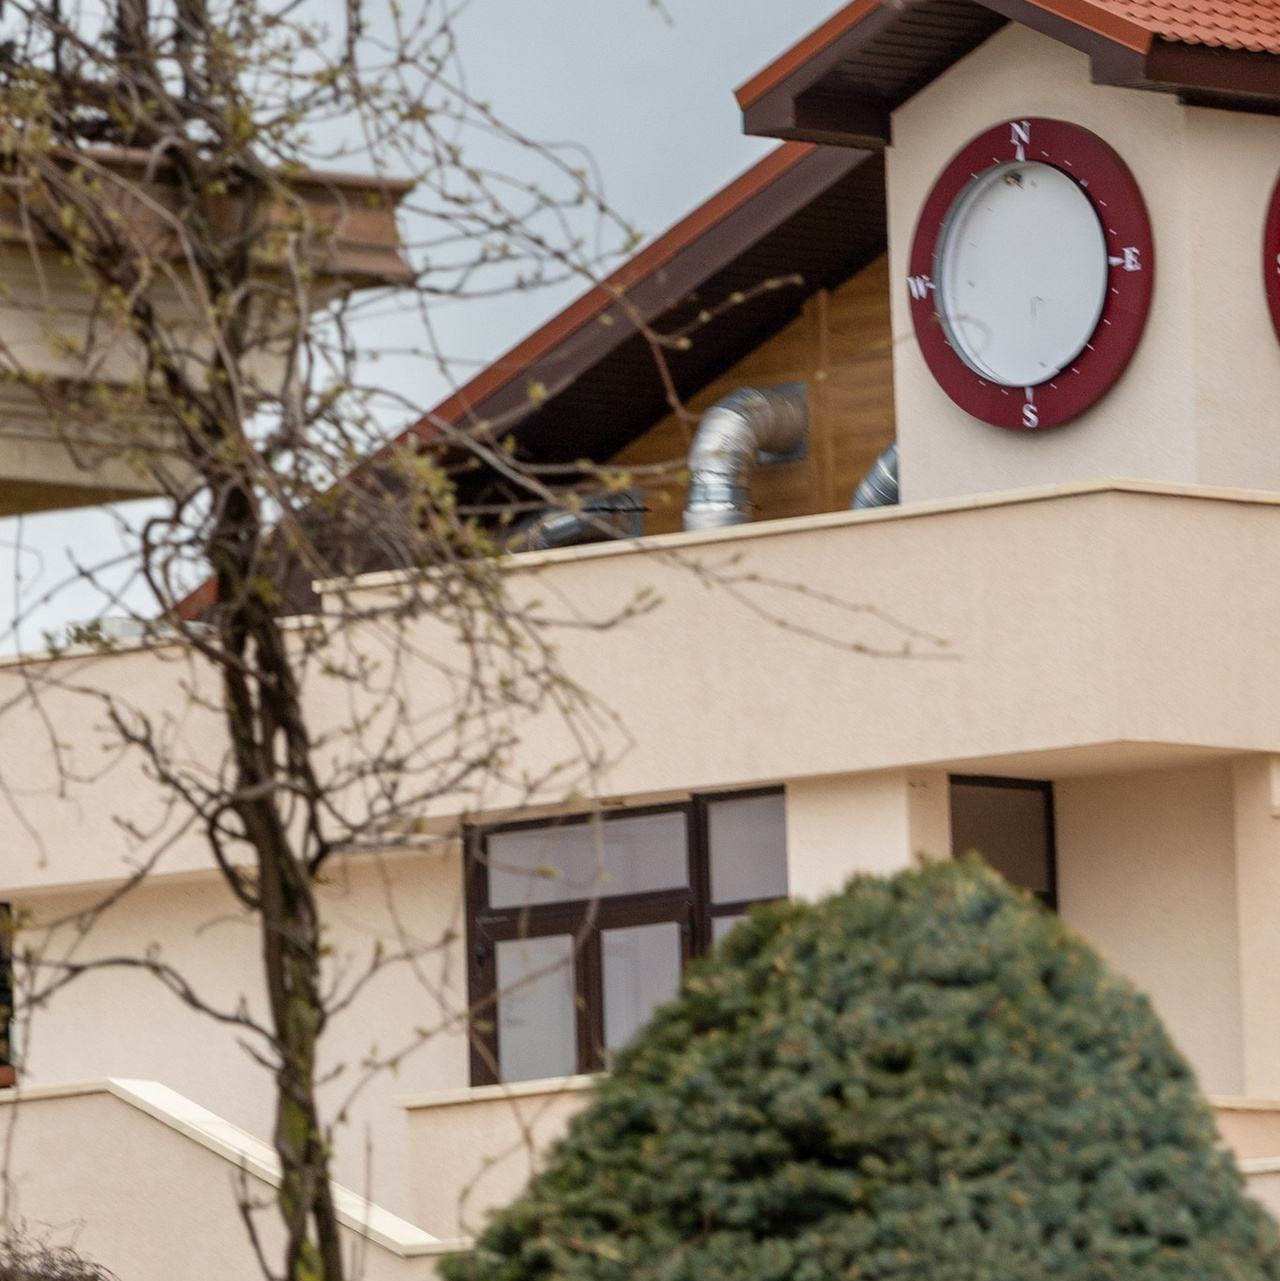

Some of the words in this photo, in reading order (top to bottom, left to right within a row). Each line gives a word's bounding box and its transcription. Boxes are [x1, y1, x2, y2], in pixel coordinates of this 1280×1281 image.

[1010, 121, 1031, 145] N
[1122, 247, 1142, 271] E
[906, 275, 930, 300] W
[1022, 404, 1039, 428] S
